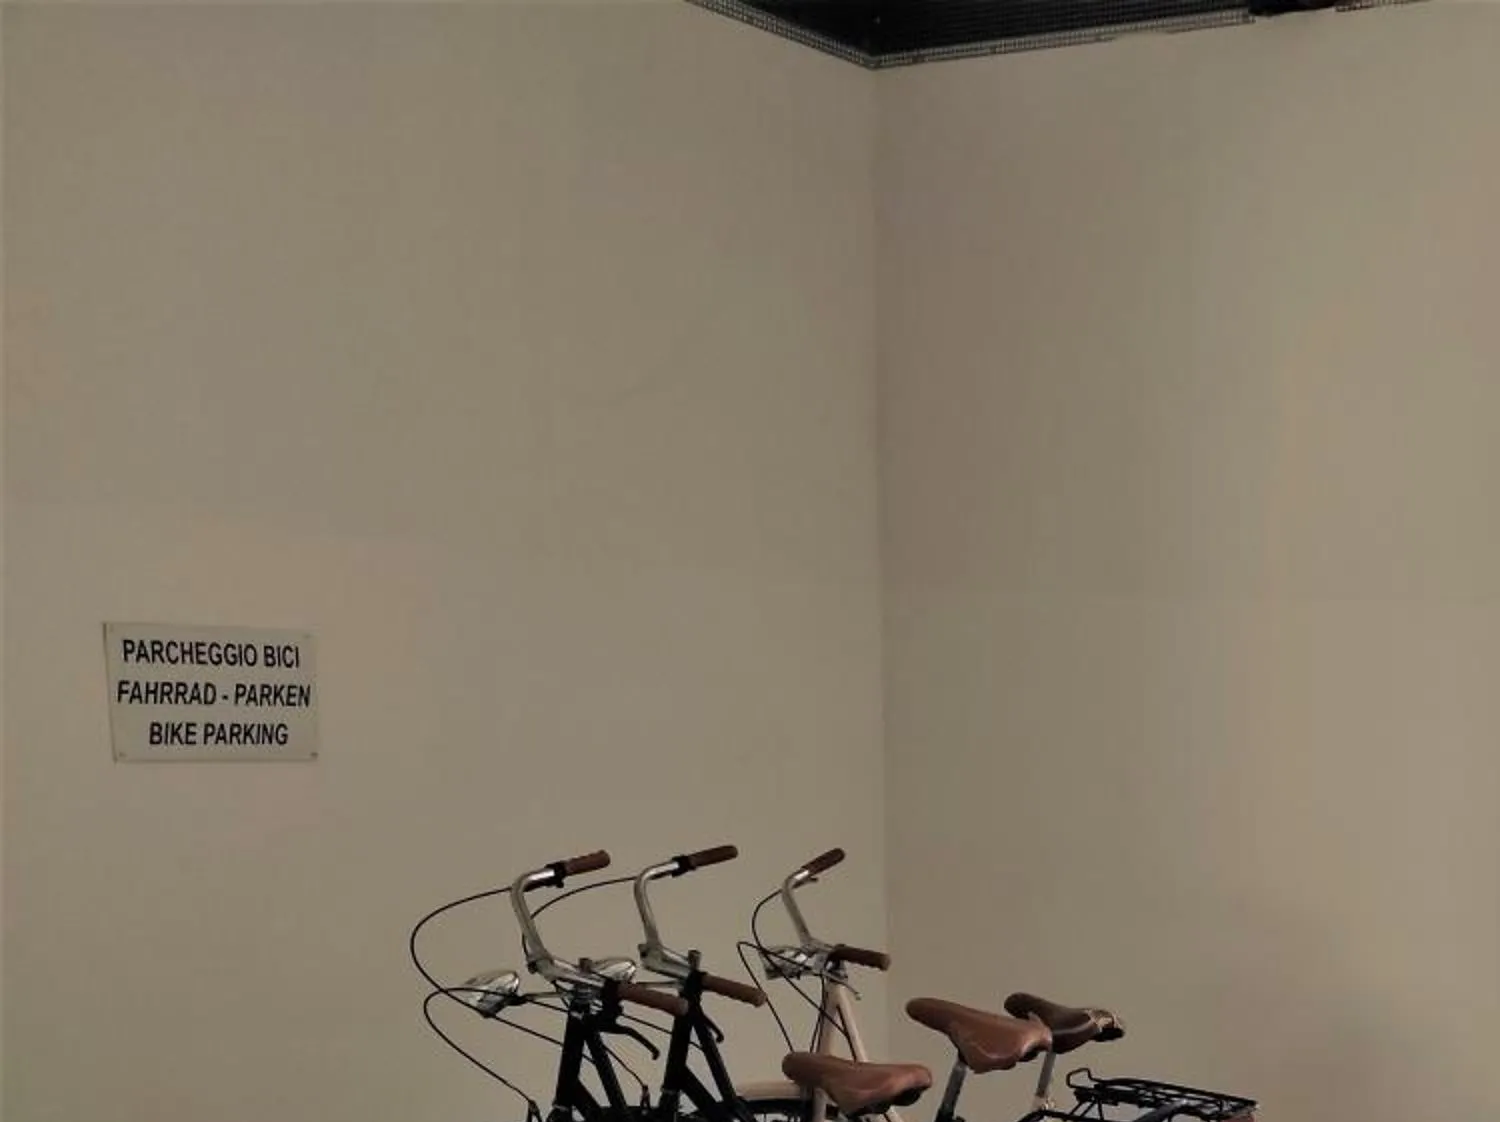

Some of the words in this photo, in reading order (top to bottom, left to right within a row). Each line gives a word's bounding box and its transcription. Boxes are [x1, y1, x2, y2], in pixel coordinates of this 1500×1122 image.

[122, 639, 258, 667] PARCHEGGIO
[263, 646, 300, 668] BICI
[117, 680, 217, 705] FAHRRAD
[234, 683, 311, 708] PARKEN
[149, 722, 198, 745] BIKE
[203, 723, 289, 745] PARKING
